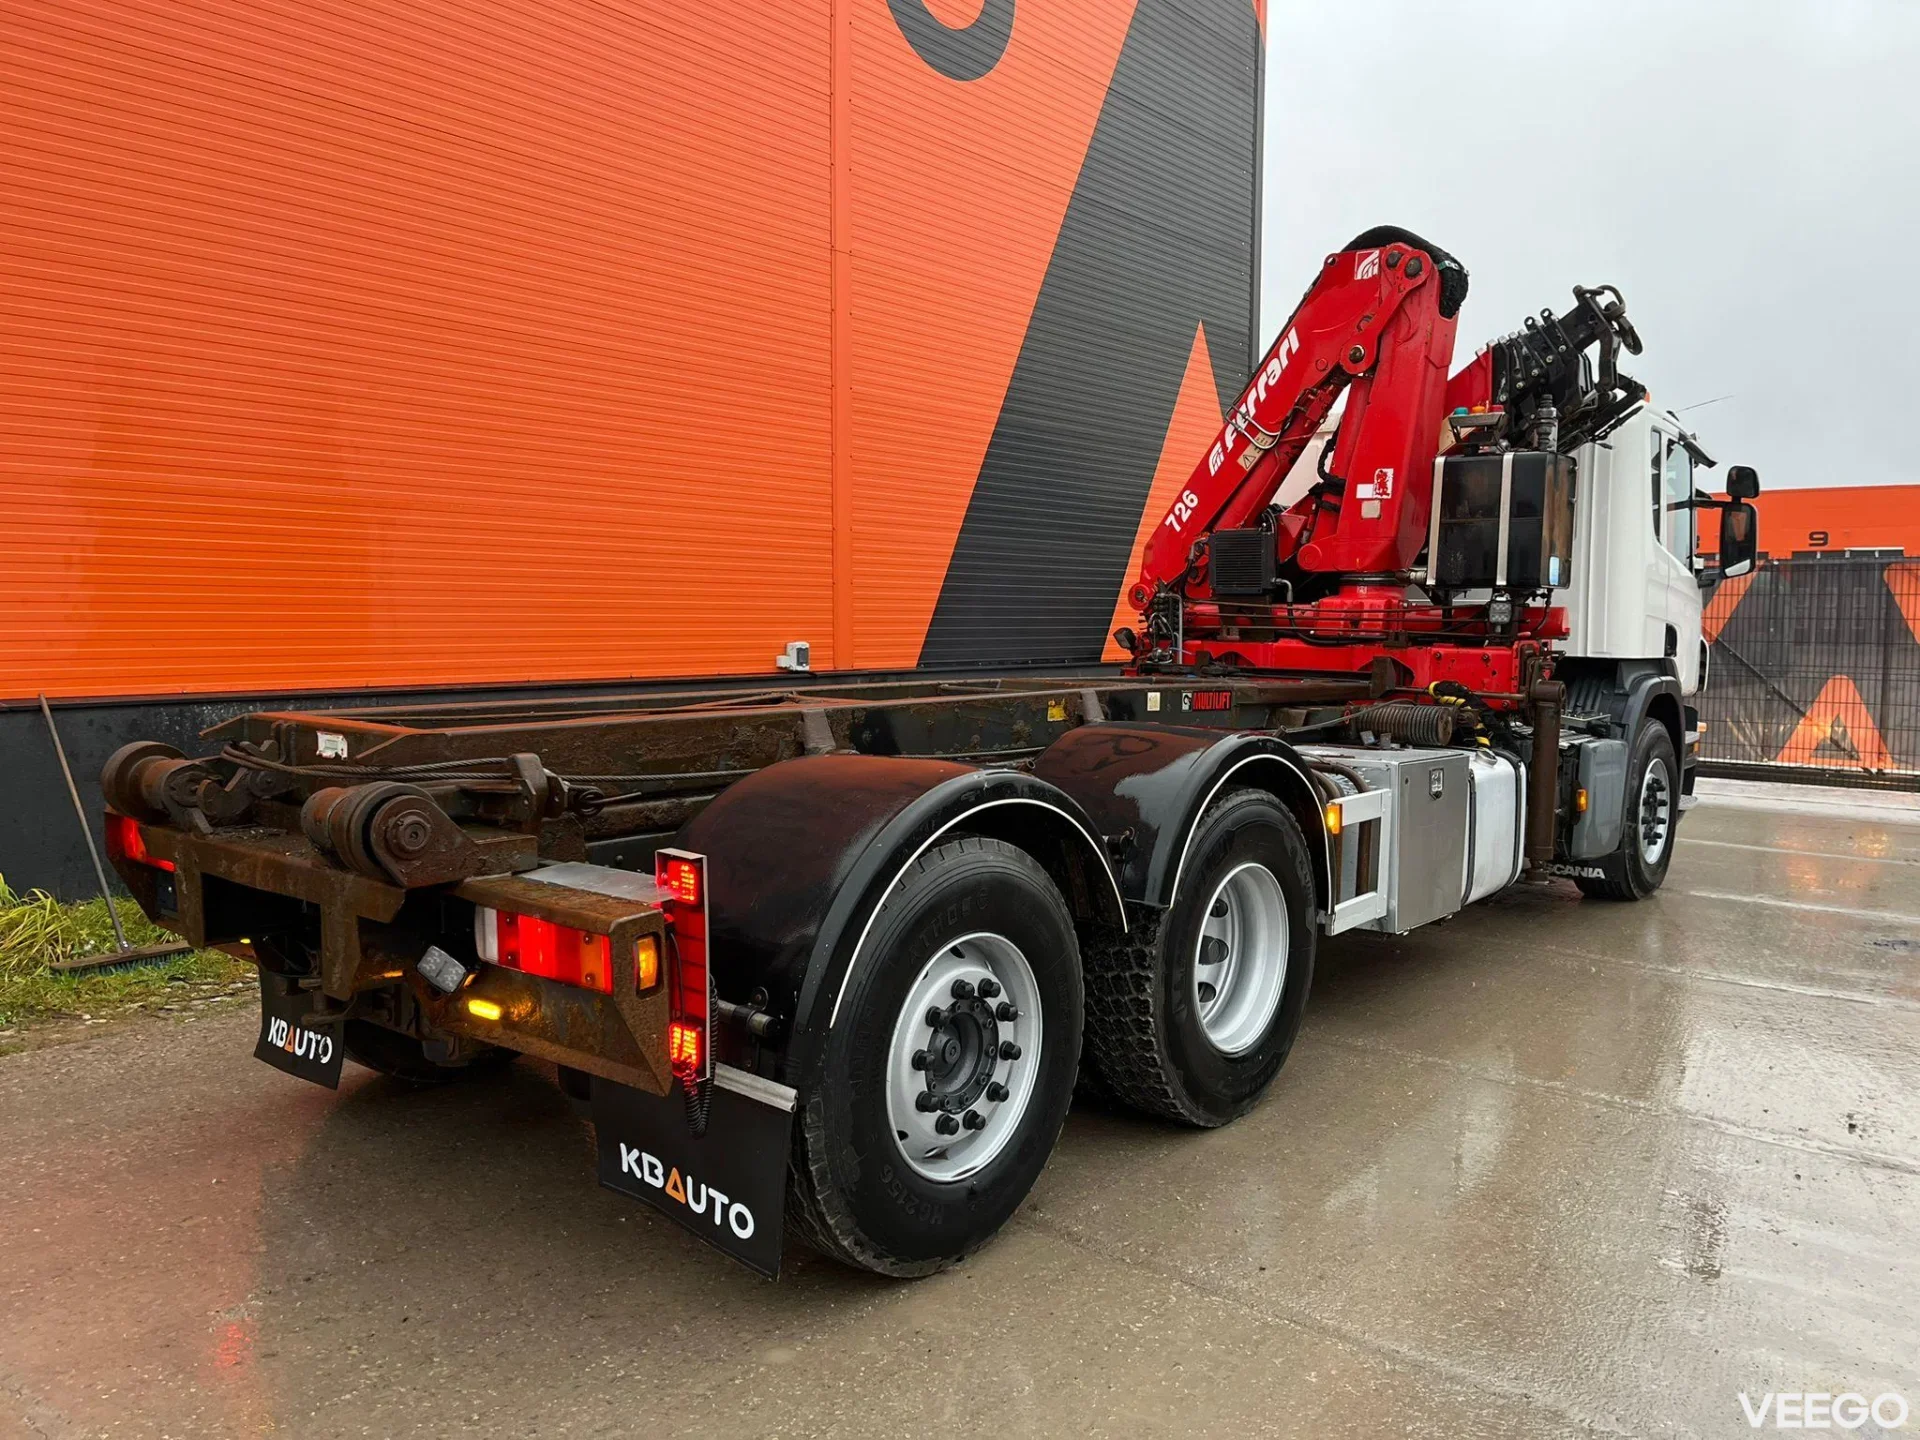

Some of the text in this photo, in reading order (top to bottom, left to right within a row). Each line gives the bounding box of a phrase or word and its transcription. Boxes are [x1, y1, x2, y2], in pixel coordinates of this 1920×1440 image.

[1224, 326, 1300, 452] Ferrari
[1165, 489, 1199, 532] 726
[1808, 531, 1829, 547] 9
[1192, 692, 1231, 710] MULTILIFT
[267, 1016, 333, 1064] KBAUTO
[619, 1142, 755, 1240] KBAUTO
